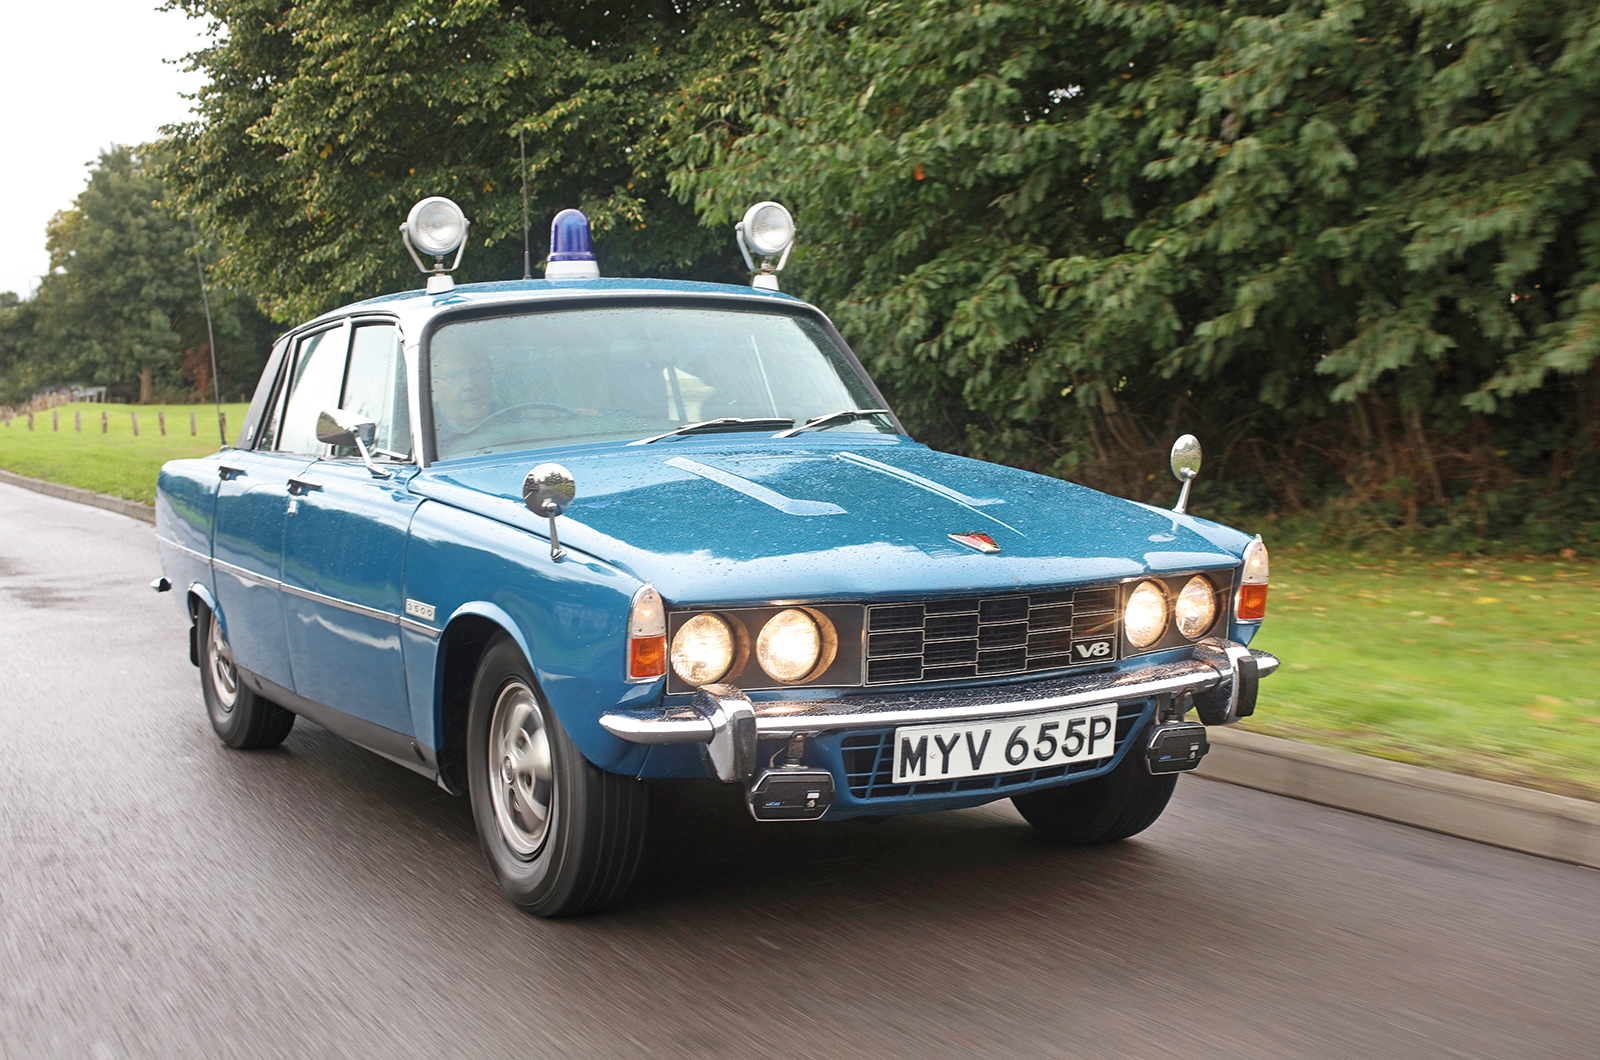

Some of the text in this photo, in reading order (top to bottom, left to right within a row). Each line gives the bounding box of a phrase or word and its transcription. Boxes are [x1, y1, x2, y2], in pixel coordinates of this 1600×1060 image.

[407, 602, 433, 617] 3500
[1075, 641, 1111, 658] V8
[900, 715, 1112, 777] MYV 655P
